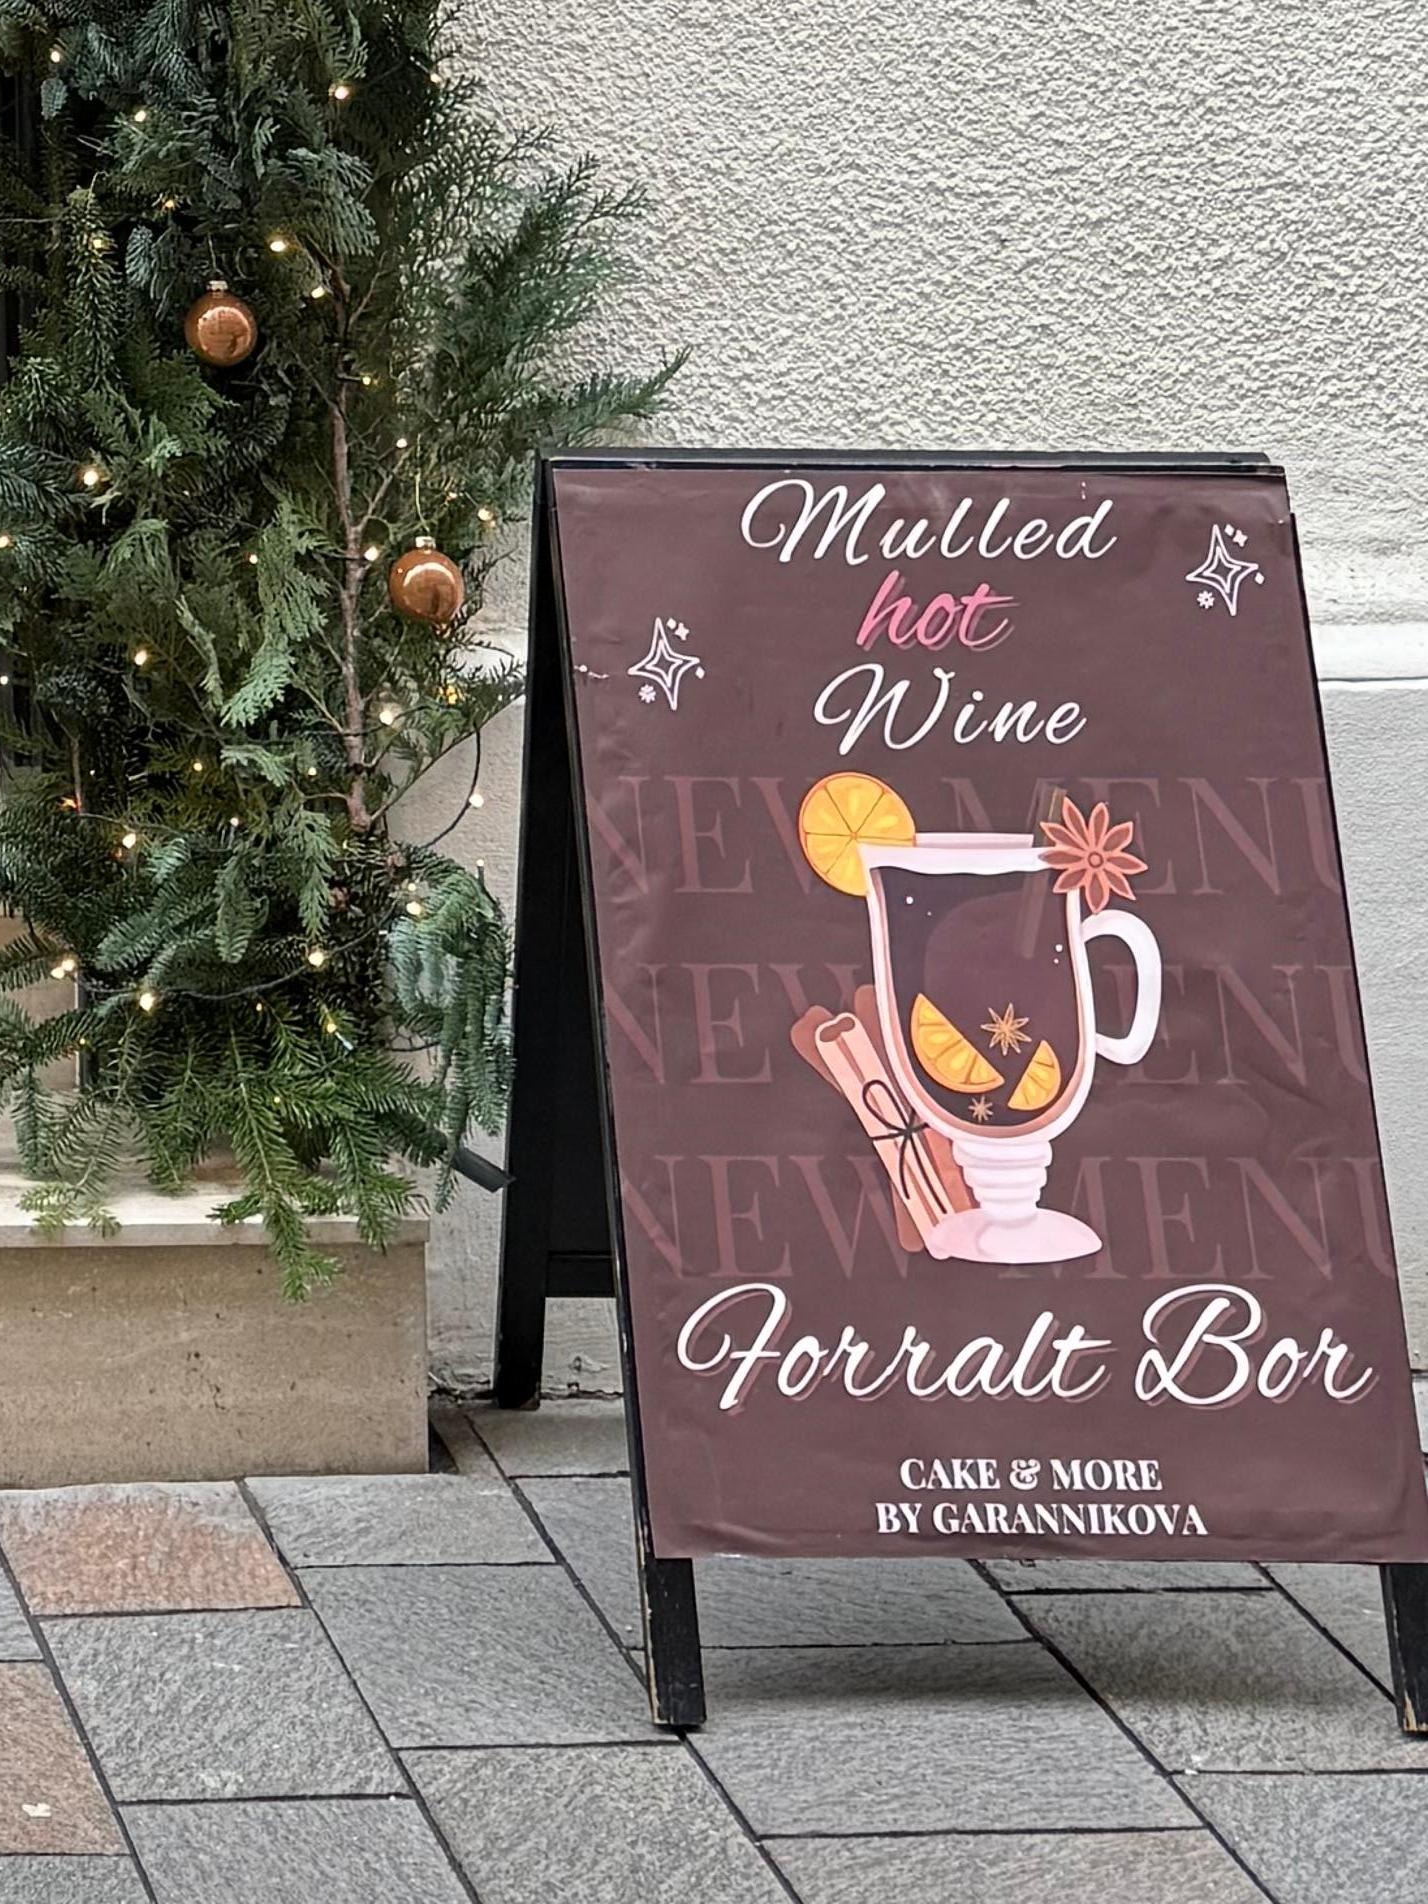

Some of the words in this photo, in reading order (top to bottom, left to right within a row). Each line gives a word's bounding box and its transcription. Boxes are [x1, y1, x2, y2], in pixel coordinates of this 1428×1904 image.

[741, 479, 1117, 565] Mulled
[856, 570, 1014, 647] hot
[814, 663, 1087, 755] Wine
[677, 1283, 1111, 1410] Forralt
[1135, 1284, 1374, 1405] Bor
[900, 1458, 1001, 1490] CAKE
[1009, 1458, 1041, 1491] &
[1050, 1459, 1163, 1491] MORE
[875, 1502, 923, 1534] BY
[932, 1502, 1209, 1535] GARANNIKOVA
